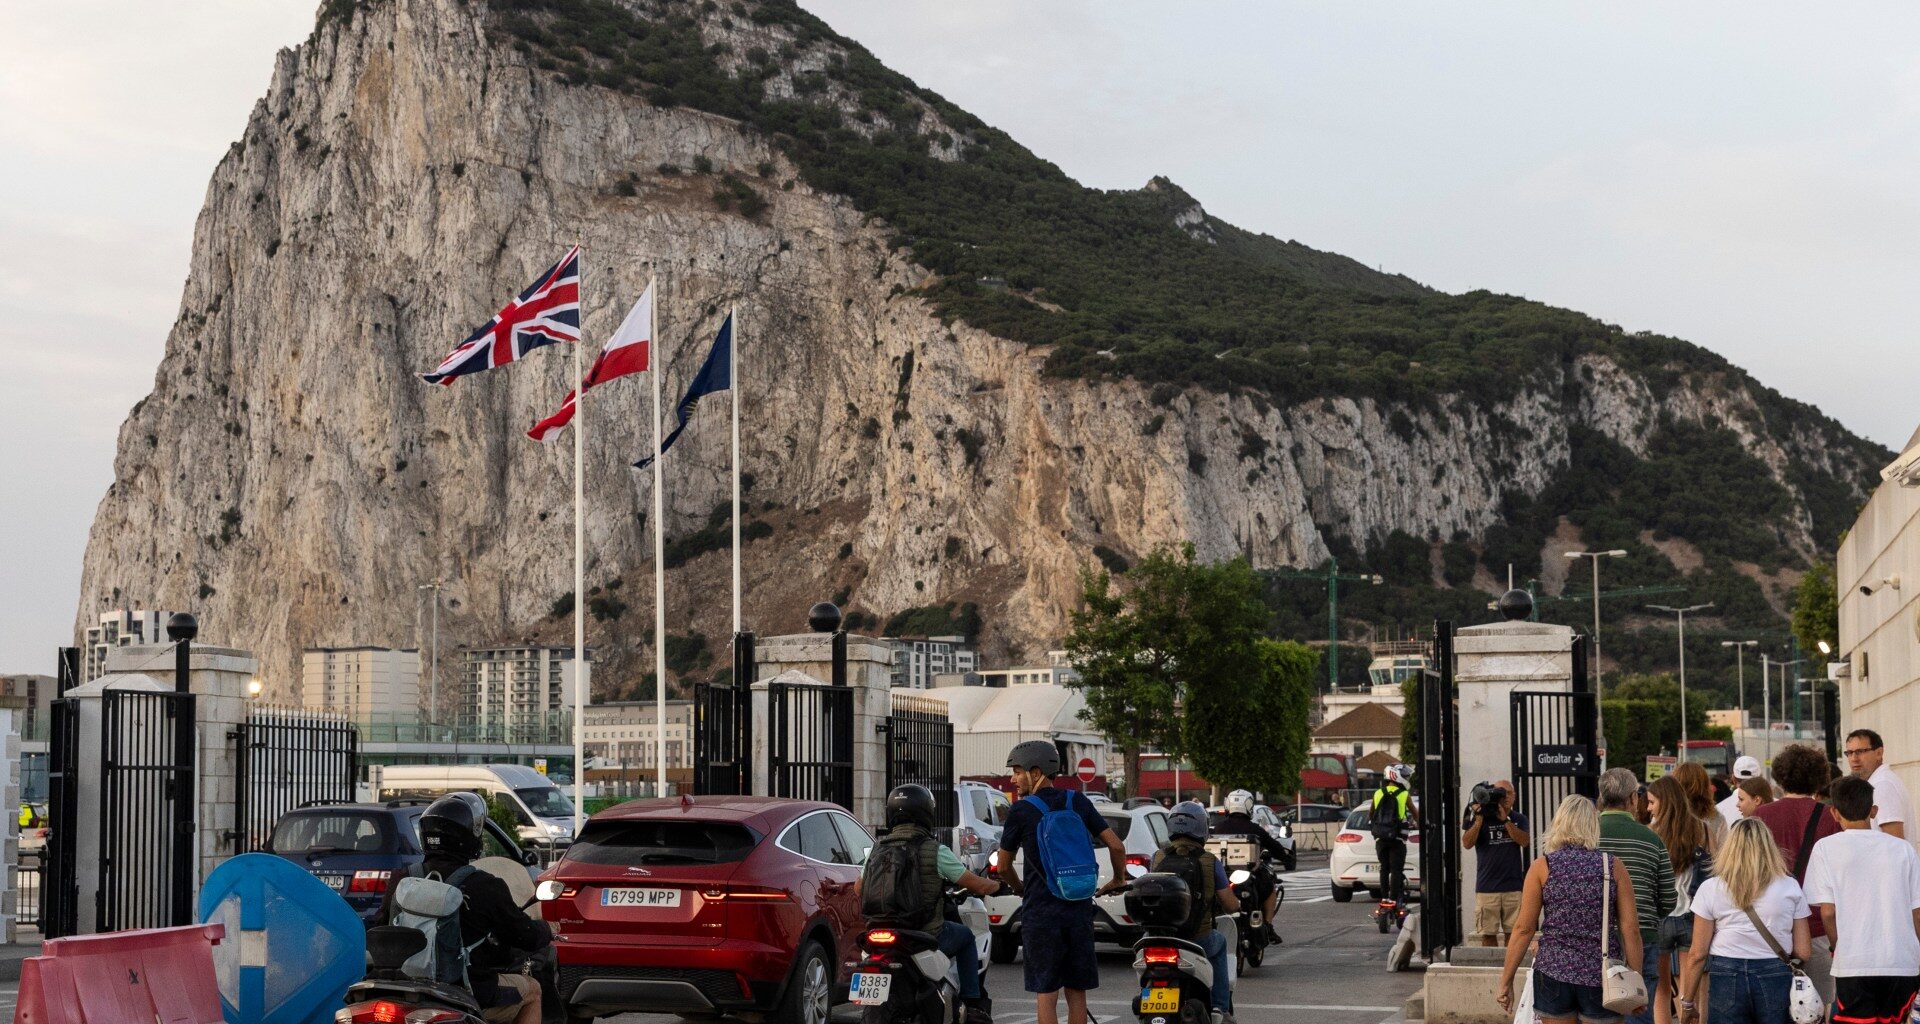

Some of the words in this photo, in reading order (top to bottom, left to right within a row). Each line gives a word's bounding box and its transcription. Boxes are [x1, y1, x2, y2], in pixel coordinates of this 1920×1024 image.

[1537, 753, 1571, 764] Gibraltar
[611, 891, 644, 903] 6799
[648, 891, 675, 904] MPP
[861, 976, 888, 987] 8383
[859, 988, 880, 998] MXG
